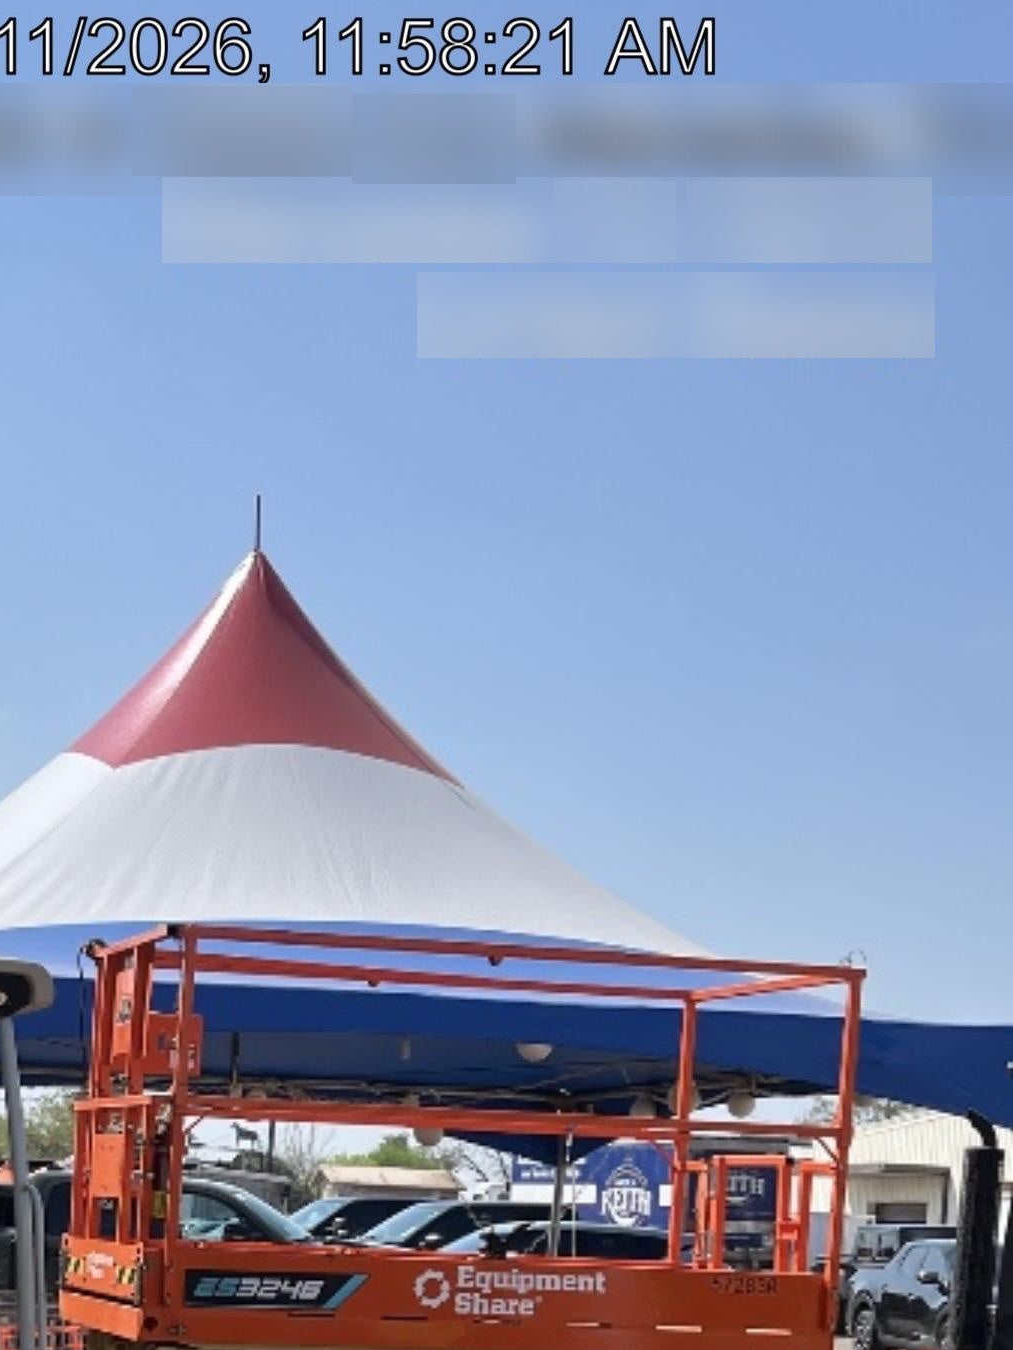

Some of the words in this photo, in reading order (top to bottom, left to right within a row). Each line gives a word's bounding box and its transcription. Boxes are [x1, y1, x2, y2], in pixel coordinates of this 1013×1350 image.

[194, 1277, 325, 1300] ES3246
[456, 1265, 607, 1293] Equipment
[454, 1292, 535, 1316] Share
